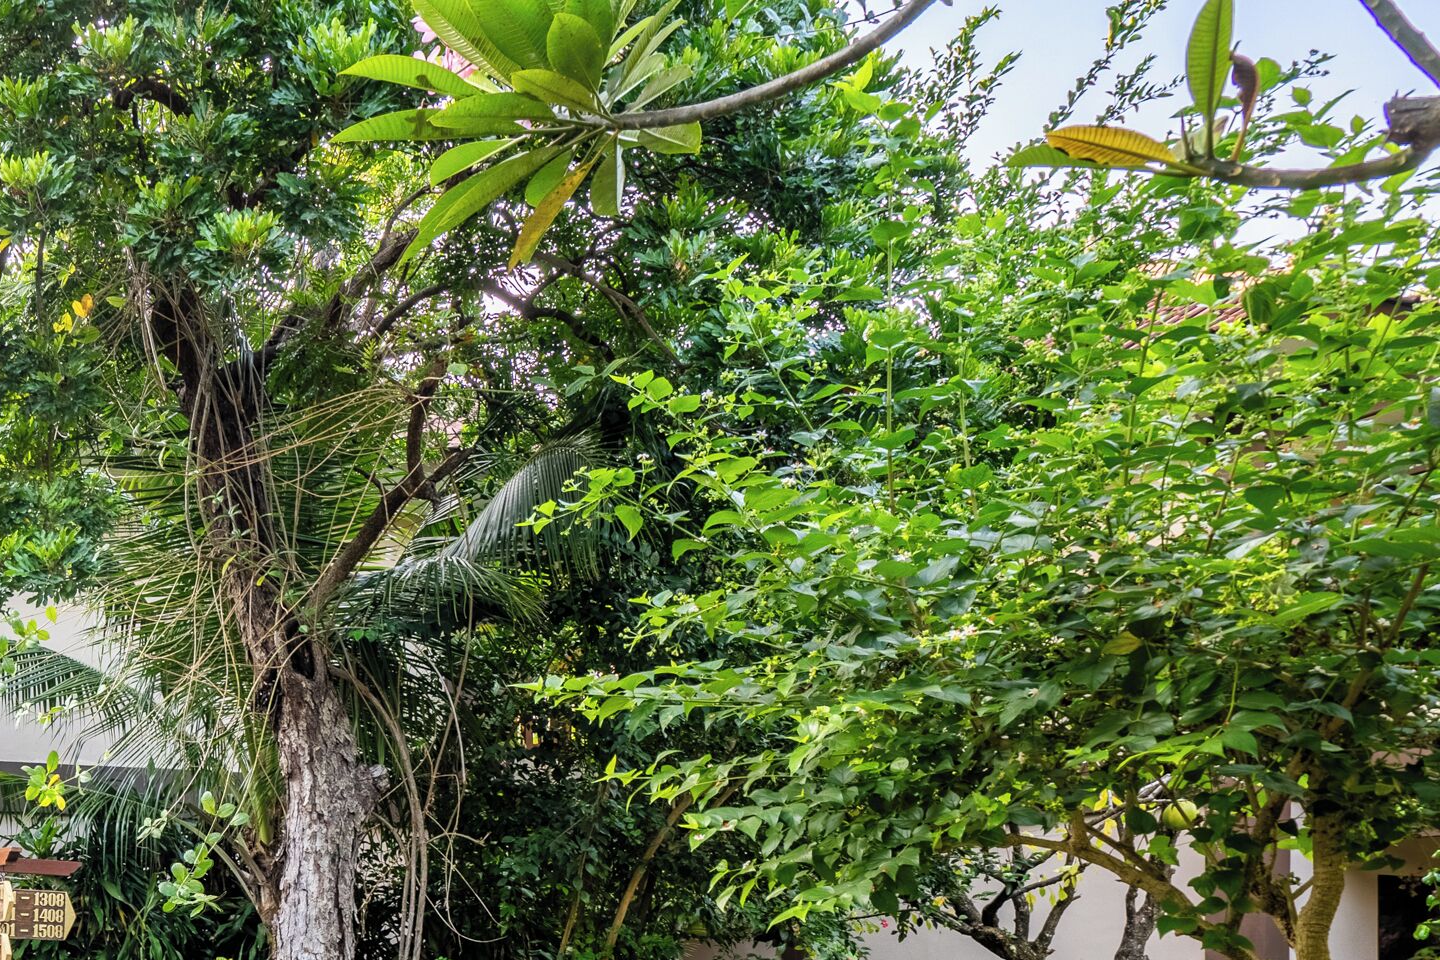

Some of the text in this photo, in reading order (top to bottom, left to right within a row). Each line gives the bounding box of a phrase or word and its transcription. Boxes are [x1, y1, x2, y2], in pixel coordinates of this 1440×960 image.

[33, 892, 65, 907] 1308
[33, 908, 64, 923] 1408
[33, 923, 64, 938] 1508
